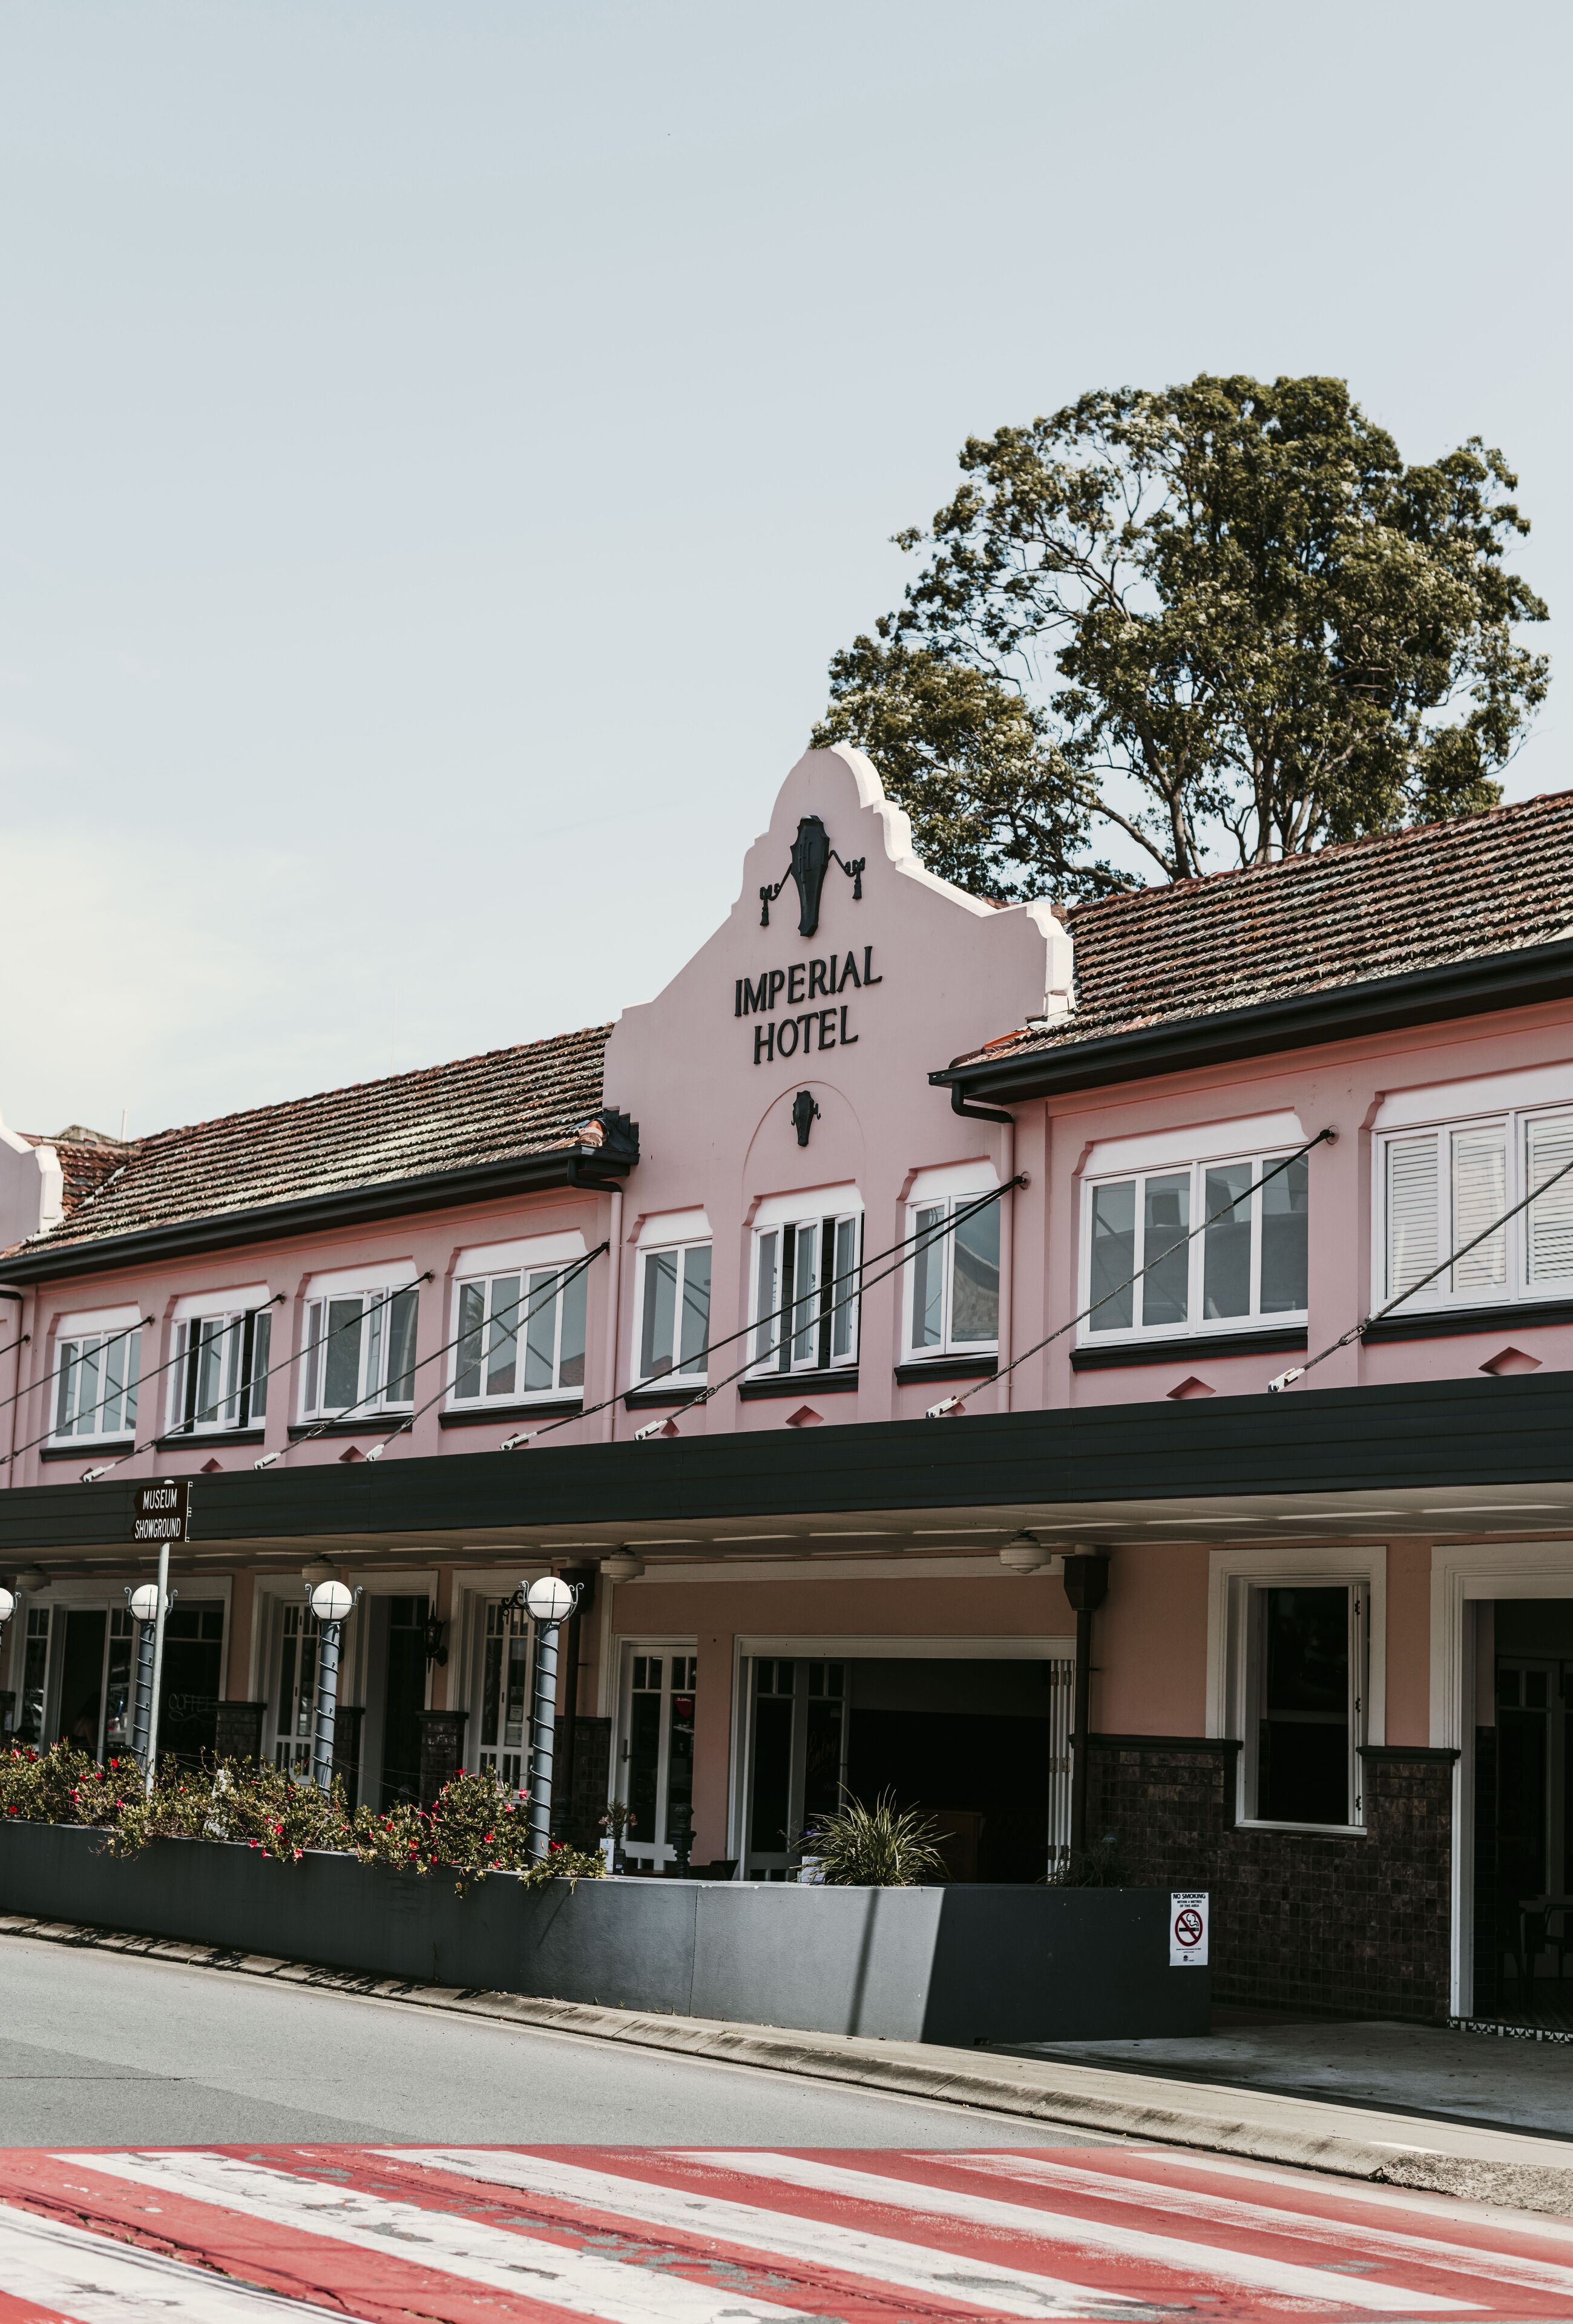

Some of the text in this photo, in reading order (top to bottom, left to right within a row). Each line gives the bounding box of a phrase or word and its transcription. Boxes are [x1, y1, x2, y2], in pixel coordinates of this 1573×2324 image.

[734, 946, 882, 1017] IMPERIAL
[754, 1005, 859, 1065] HOTEL
[143, 1488, 177, 1509] MUSEUM
[134, 1517, 181, 1539] SHOWGROUND
[168, 1693, 217, 1713] COFFEE
